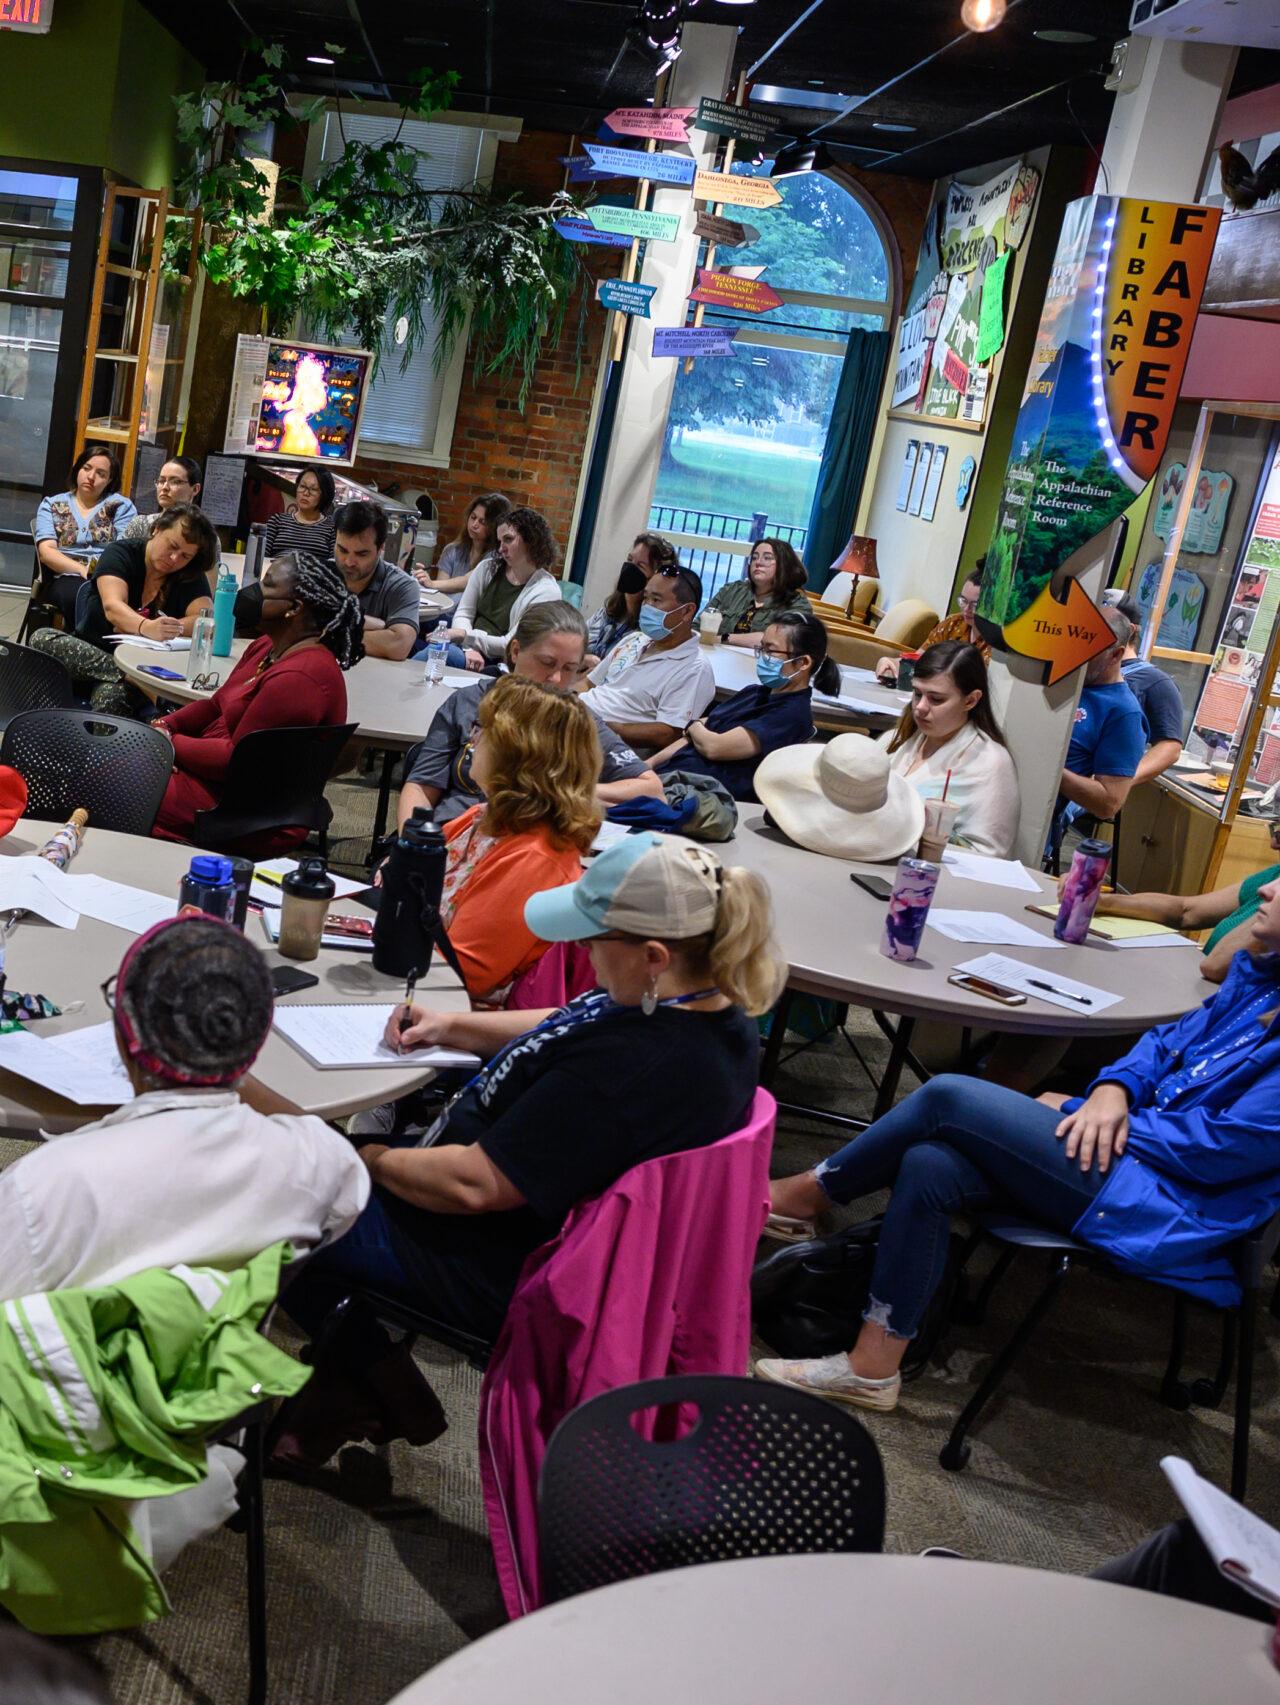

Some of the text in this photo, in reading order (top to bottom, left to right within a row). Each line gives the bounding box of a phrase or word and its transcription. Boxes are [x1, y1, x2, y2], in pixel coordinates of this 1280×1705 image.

[589, 146, 604, 154] FORT
[668, 174, 688, 182] MILES
[740, 179, 769, 189] GEORGIA
[711, 274, 736, 285] PIGEON
[716, 282, 754, 294] TENNESSEE
[1106, 207, 1154, 376] LIBRARY
[1120, 208, 1208, 450] FABER
[1036, 346, 1058, 364] Faber
[1028, 379, 1055, 398] Library
[1044, 460, 1066, 474] The
[1039, 477, 1112, 499] Appalachian
[1035, 495, 1093, 513] Reference
[1031, 511, 1068, 526] Room
[1033, 619, 1098, 644] This Way
